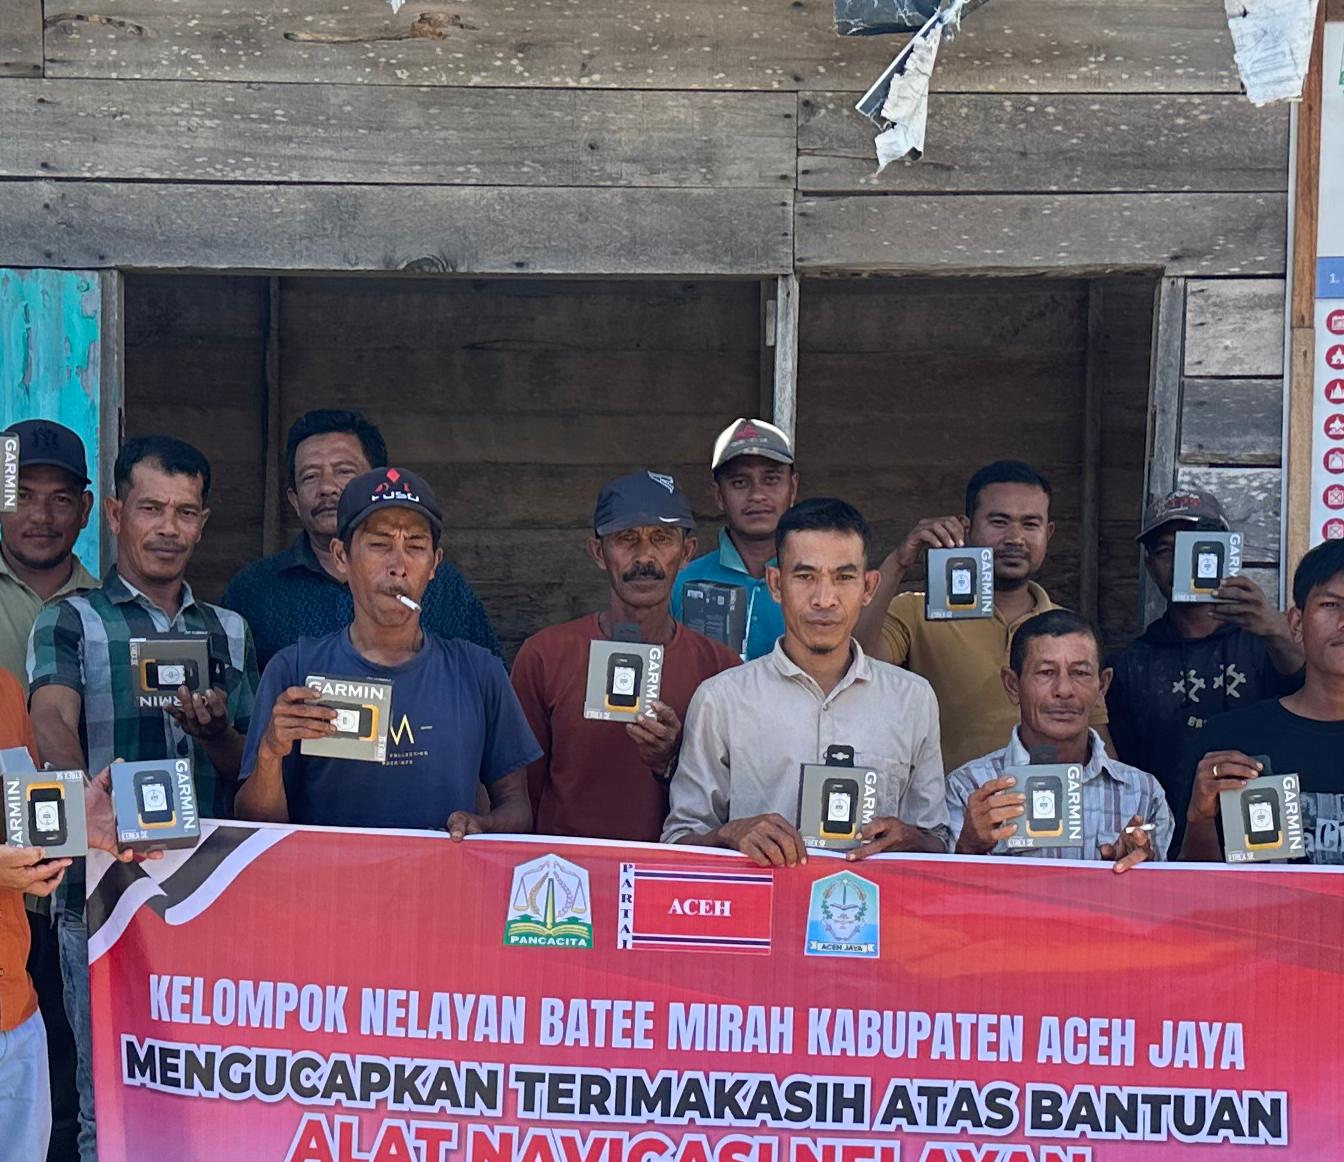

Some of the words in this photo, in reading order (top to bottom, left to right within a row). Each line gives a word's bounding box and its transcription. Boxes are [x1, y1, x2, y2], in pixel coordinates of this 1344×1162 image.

[1329, 273, 1340, 283] 1.
[4, 439, 17, 507] GARMIN
[981, 549, 993, 612] GARMIN
[175, 760, 196, 829] GARMIN
[1067, 766, 1081, 840] GARMIN
[1283, 776, 1302, 850] GARMIN
[620, 863, 633, 949] PARTAI
[667, 898, 732, 918] ACEH
[510, 935, 588, 948] PANCACITA
[821, 943, 842, 952] ACEH
[844, 943, 864, 952] JAYA
[148, 974, 349, 1034] KELOMPOK
[360, 988, 525, 1044] NELAYAN
[540, 997, 655, 1050] BATEE
[668, 1003, 794, 1055] MIRAH
[808, 1006, 1024, 1064] KABUPATEN
[1038, 1017, 1135, 1067] ACEH
[1148, 1021, 1246, 1070] JAYA
[125, 1041, 497, 1110] MENGUCAPKAN
[516, 1072, 865, 1125] TERIMAKASIH
[881, 1084, 1013, 1131] ATAS
[1031, 1090, 1284, 1140] BANTUAN
